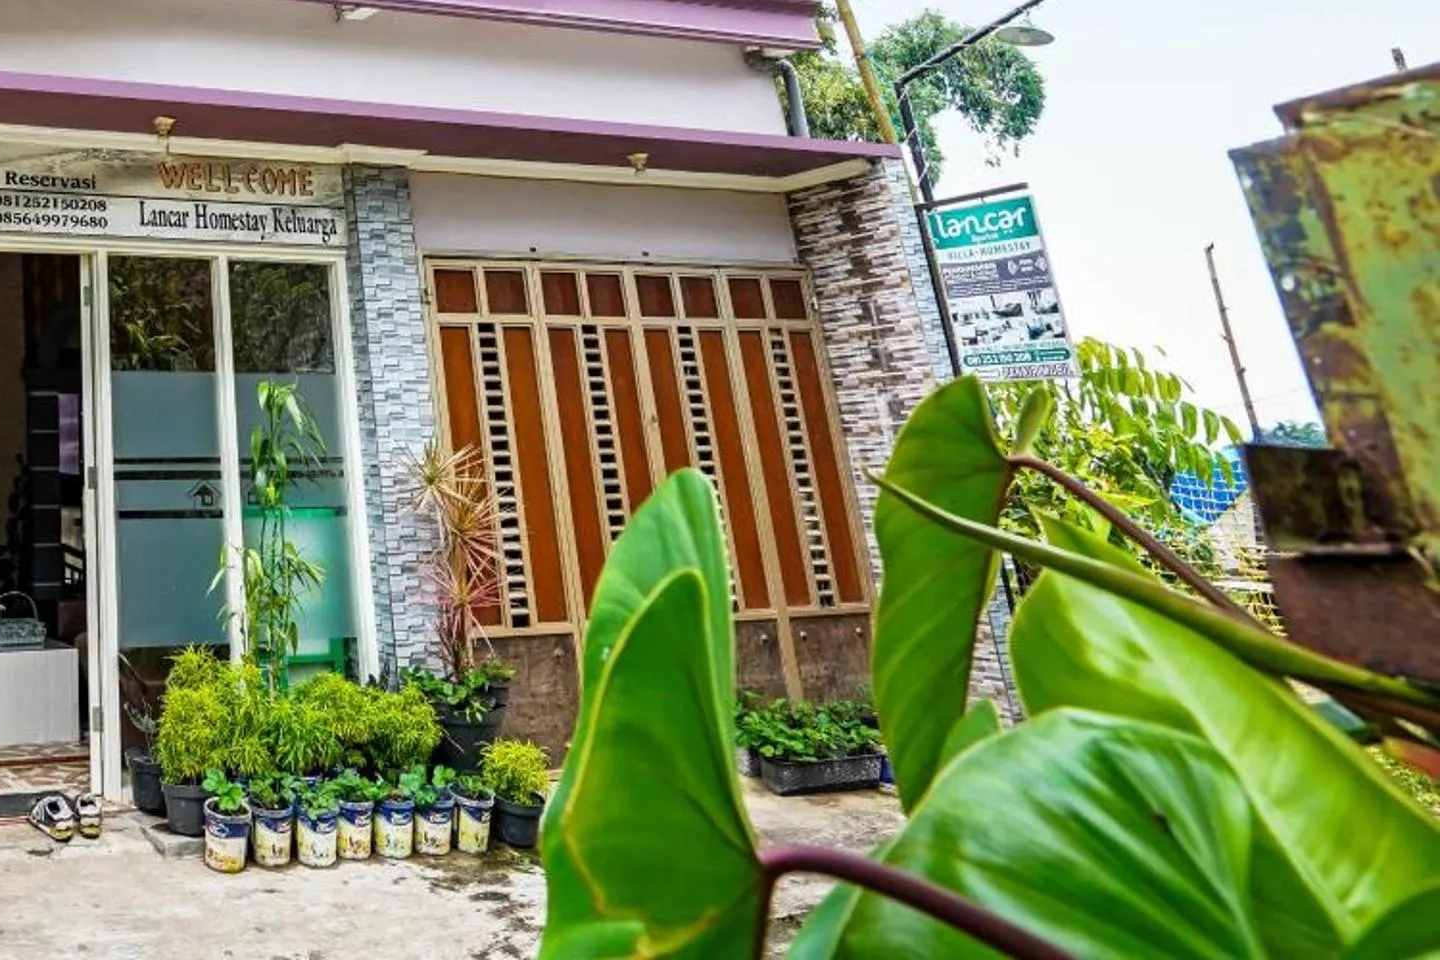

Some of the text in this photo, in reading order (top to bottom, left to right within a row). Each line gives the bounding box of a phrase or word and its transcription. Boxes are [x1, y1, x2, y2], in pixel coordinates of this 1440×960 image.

[5, 171, 97, 190] Reservasi
[158, 160, 314, 197] WELLCOME
[139, 200, 337, 243] Lancar Homestay Keluarga
